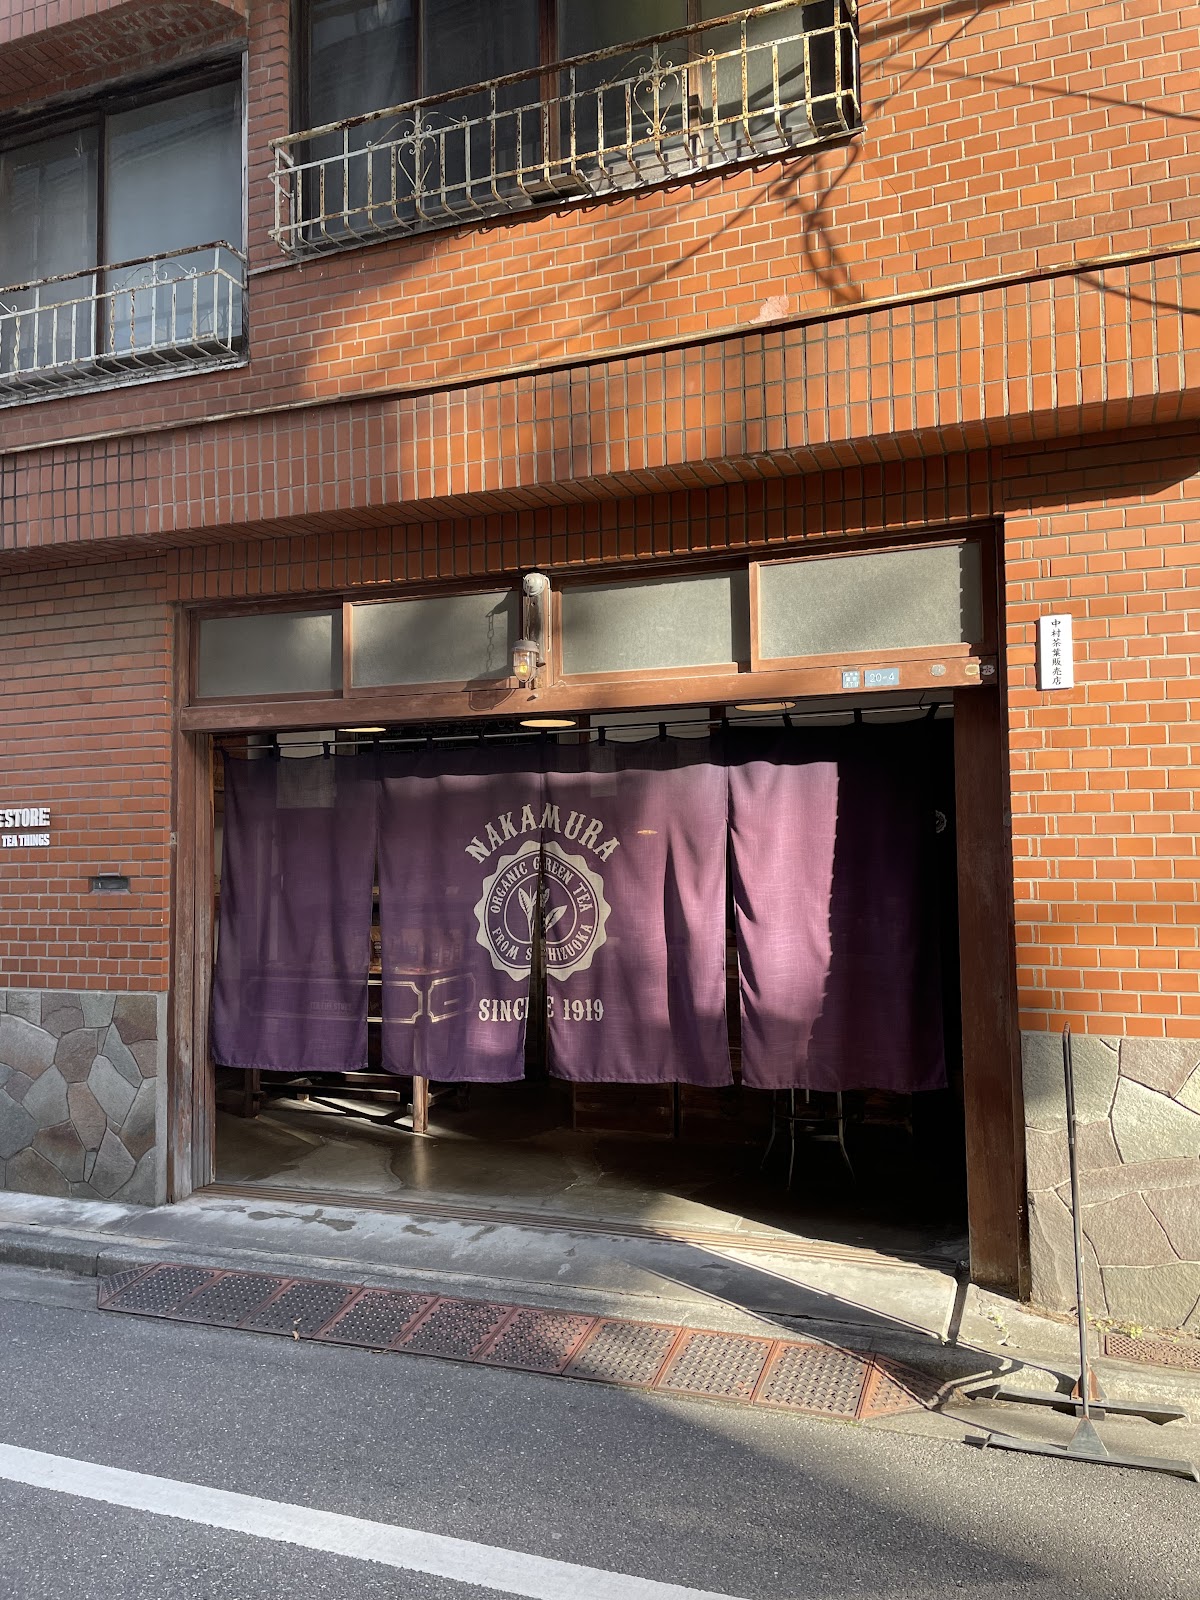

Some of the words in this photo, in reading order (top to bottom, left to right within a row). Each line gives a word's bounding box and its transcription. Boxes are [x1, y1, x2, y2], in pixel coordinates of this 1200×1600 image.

[1050, 618, 1062, 686] 中村茶葉販売店
[869, 672, 895, 683] 20-4
[1, 834, 18, 847] TEA
[18, 833, 50, 846] THINGS
[465, 803, 620, 863] NAKAMURA
[490, 861, 528, 914] ORGANIC
[532, 856, 574, 886] GREEN
[572, 881, 594, 913] TEA
[491, 926, 519, 961] FROM
[525, 924, 594, 963] SHIZUOKA
[478, 996, 555, 1022] SINCE
[562, 998, 604, 1022] 1919
